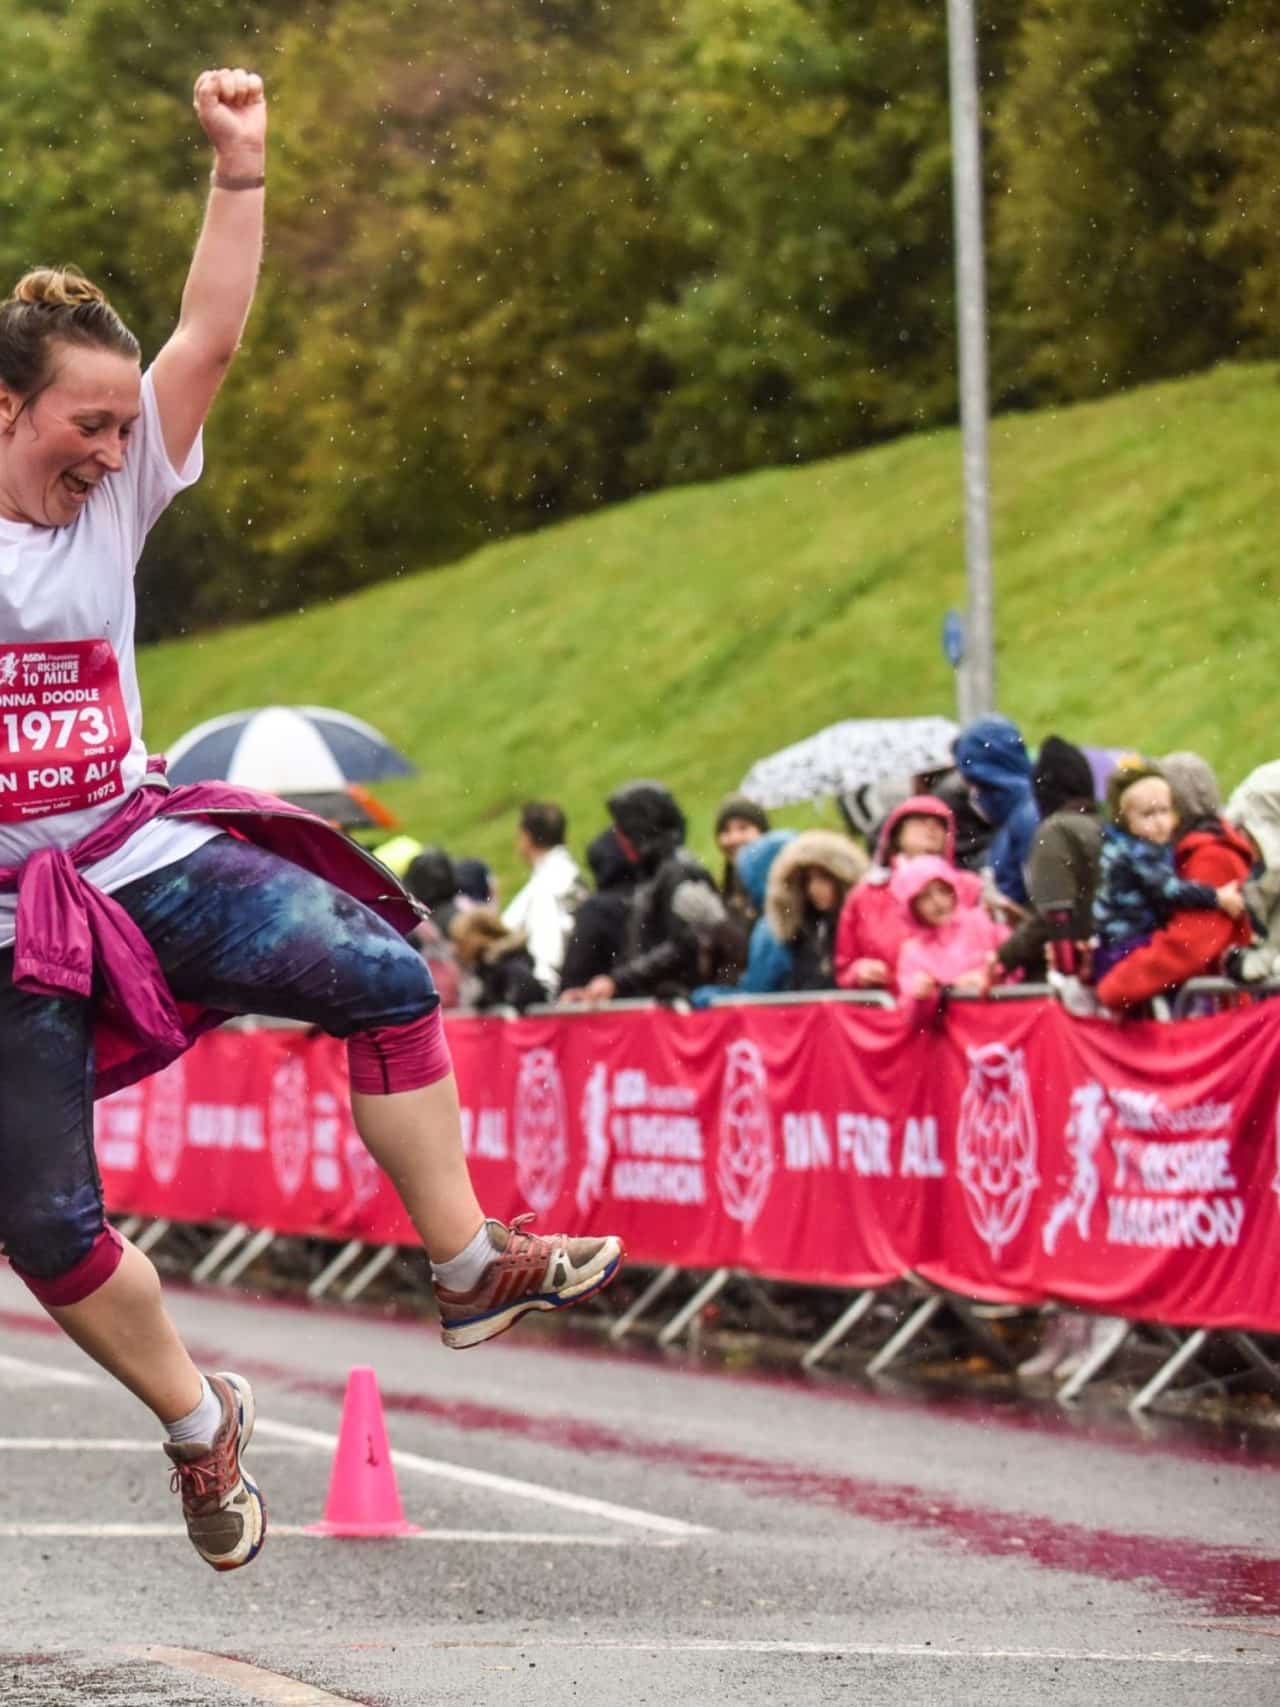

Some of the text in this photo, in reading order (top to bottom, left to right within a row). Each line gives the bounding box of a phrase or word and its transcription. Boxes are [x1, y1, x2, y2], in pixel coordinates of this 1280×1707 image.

[23, 670, 79, 687] 10 MILE
[42, 688, 100, 704] DOODLE
[28, 766, 74, 790] FOR
[87, 782, 117, 803] 11973
